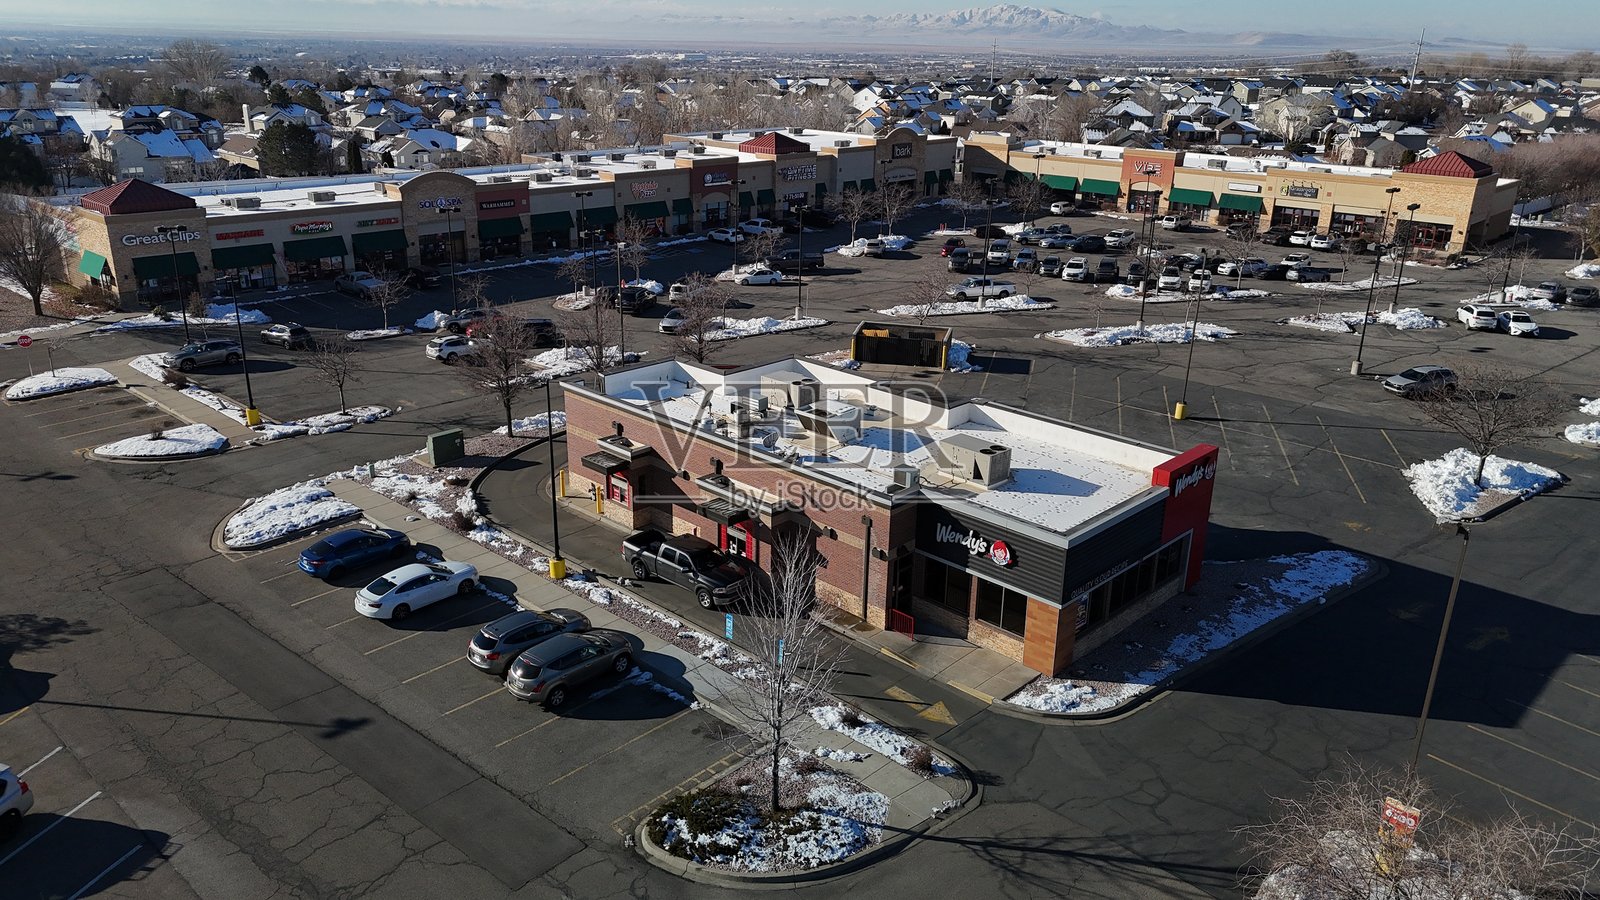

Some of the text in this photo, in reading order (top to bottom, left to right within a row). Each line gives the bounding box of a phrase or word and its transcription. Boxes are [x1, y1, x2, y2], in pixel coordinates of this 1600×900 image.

[122, 230, 201, 246] Great Clips
[1174, 464, 1205, 498] Wendy's
[936, 522, 988, 556] Wendy's
